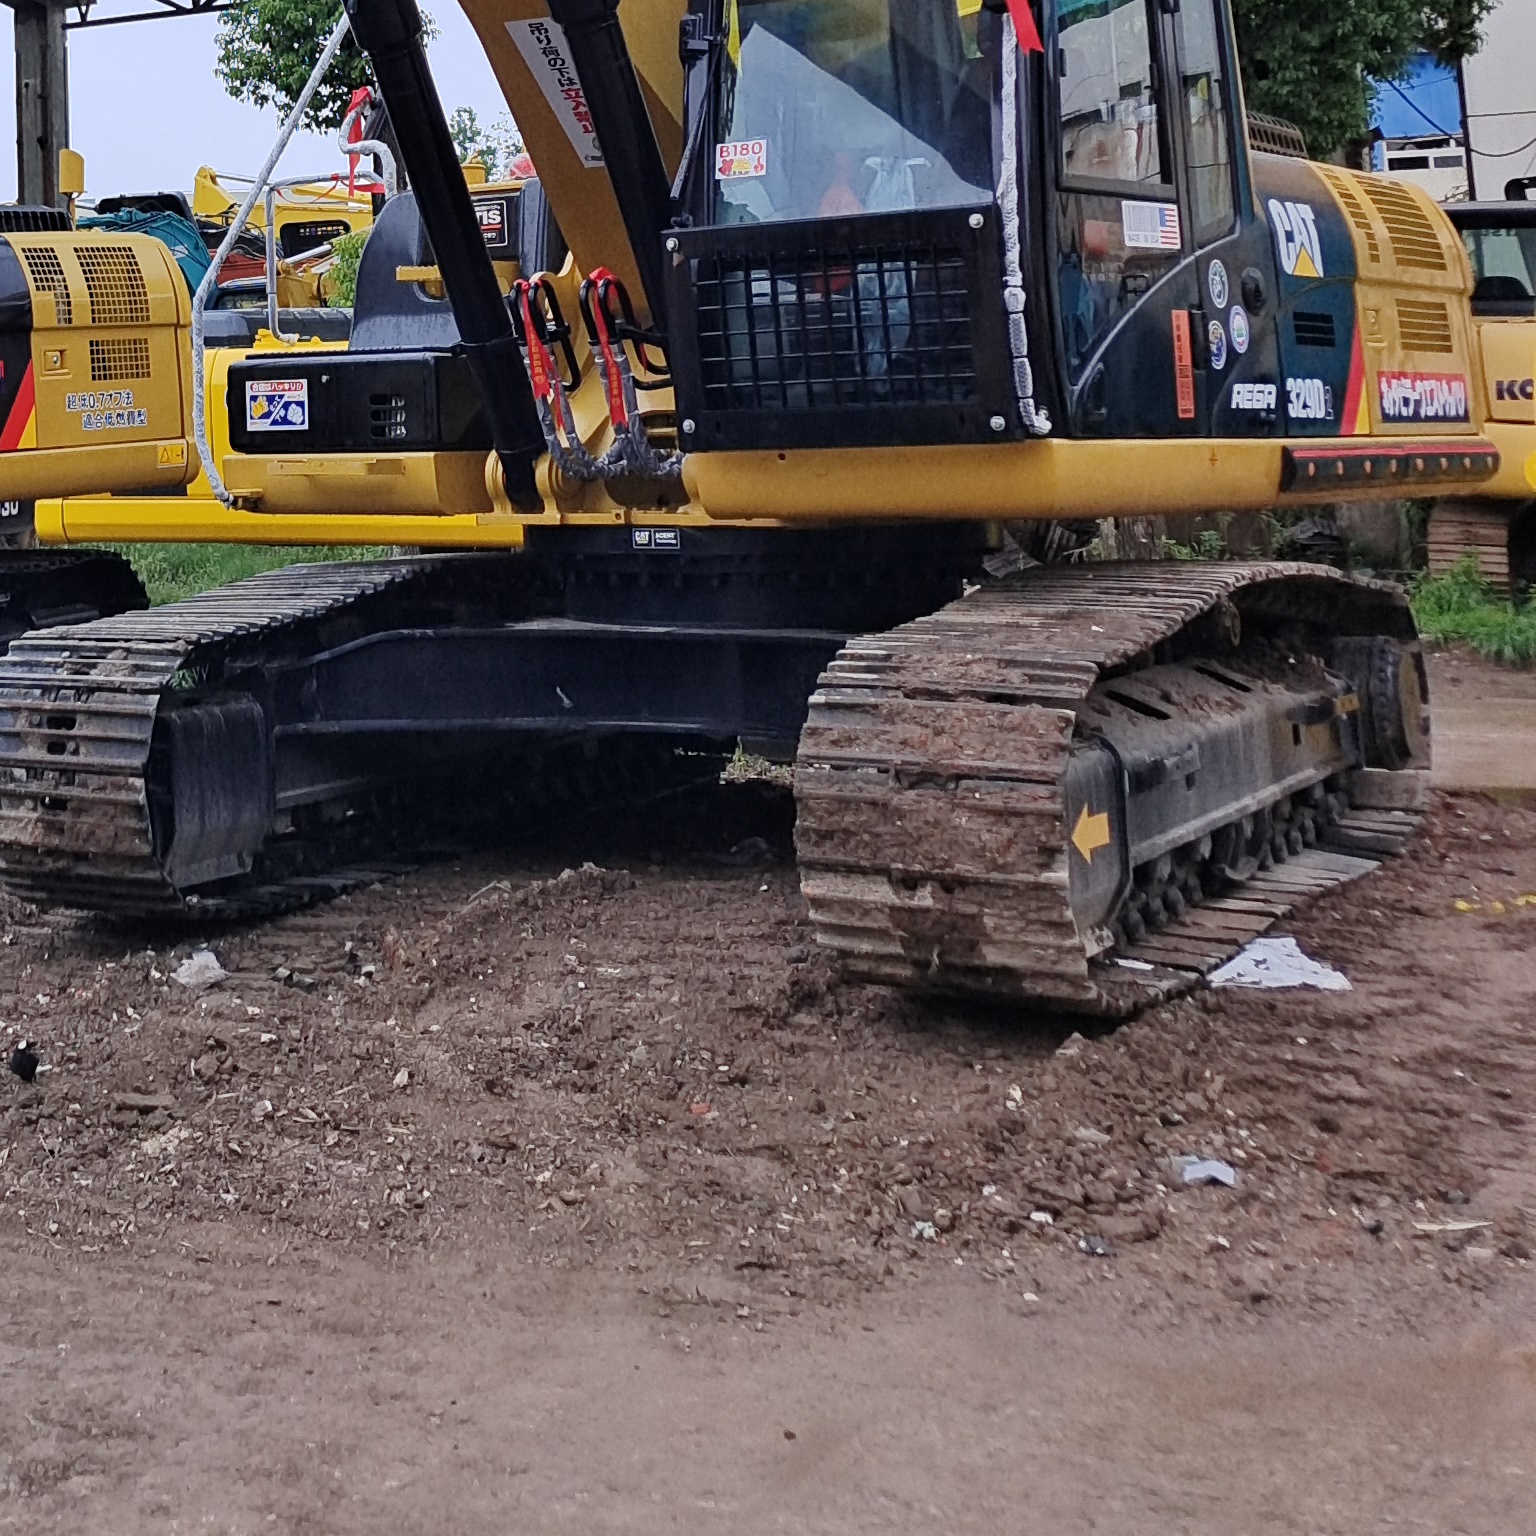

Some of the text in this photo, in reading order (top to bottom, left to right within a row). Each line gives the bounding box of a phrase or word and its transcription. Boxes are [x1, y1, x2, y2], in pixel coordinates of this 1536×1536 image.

[719, 142, 763, 159] B180
[1267, 199, 1324, 278] CAT
[1230, 383, 1278, 410] REGA
